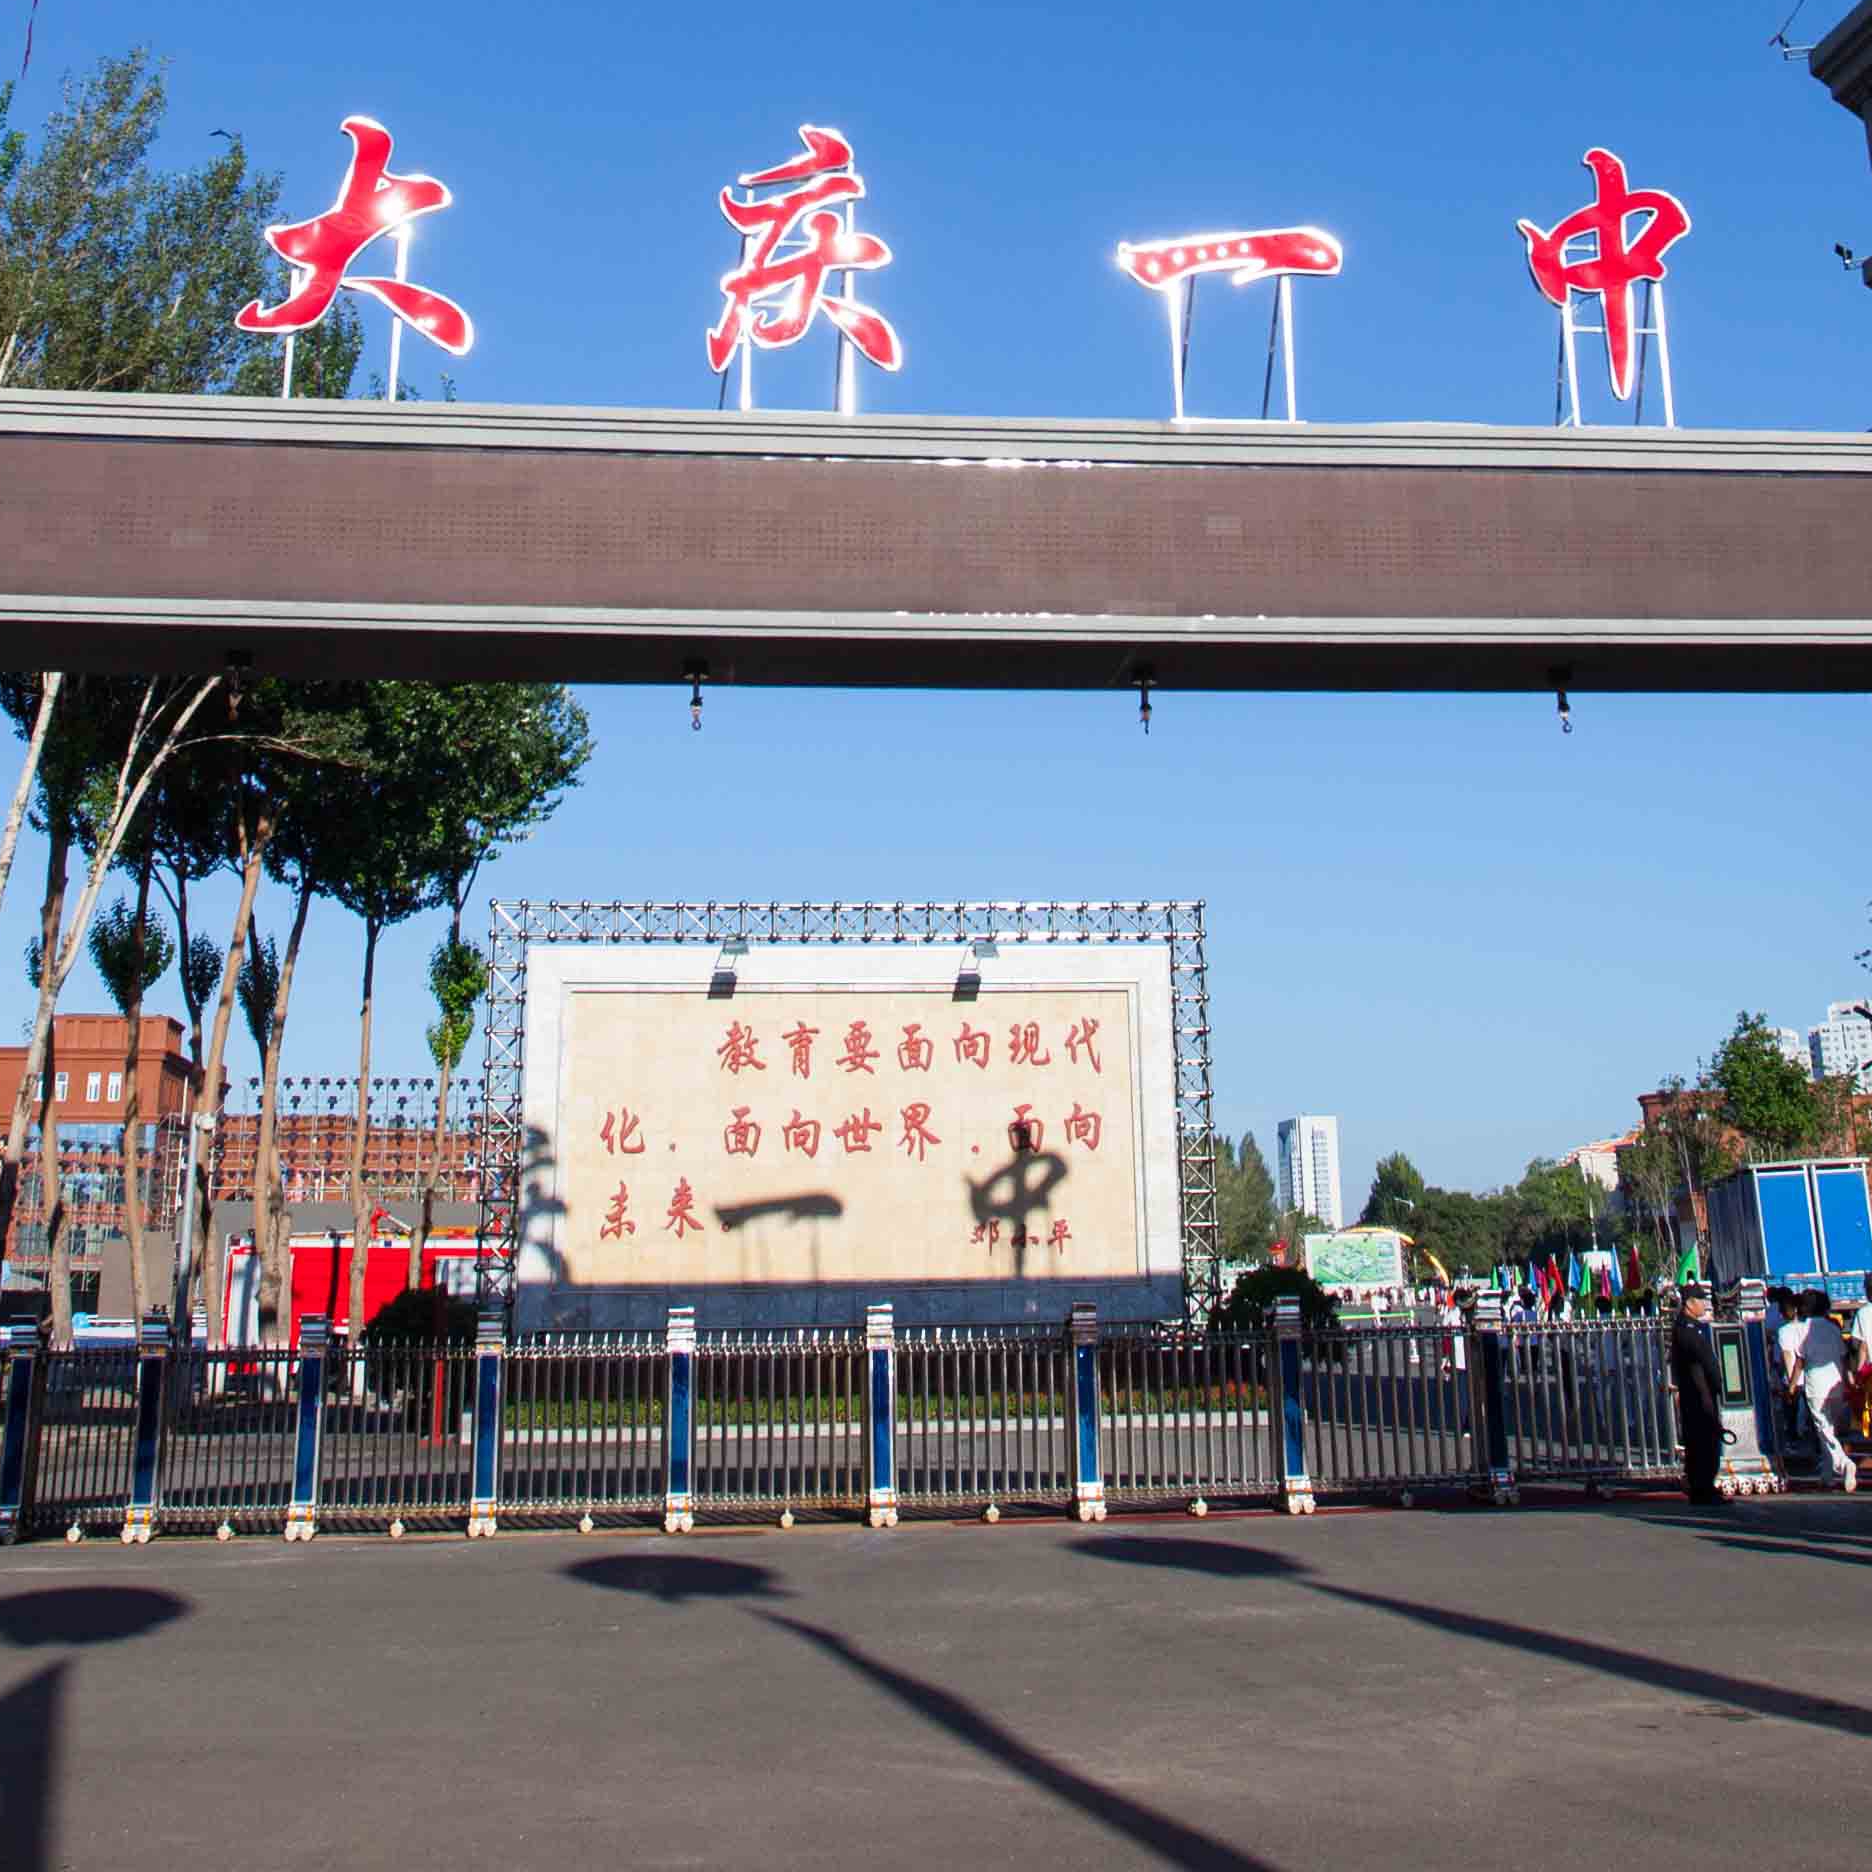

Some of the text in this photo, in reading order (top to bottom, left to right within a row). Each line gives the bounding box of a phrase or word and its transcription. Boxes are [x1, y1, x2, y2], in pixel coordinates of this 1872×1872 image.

[235, 114, 1691, 402] 大庆一中
[717, 1017, 1102, 1078] 教育要面向现代
